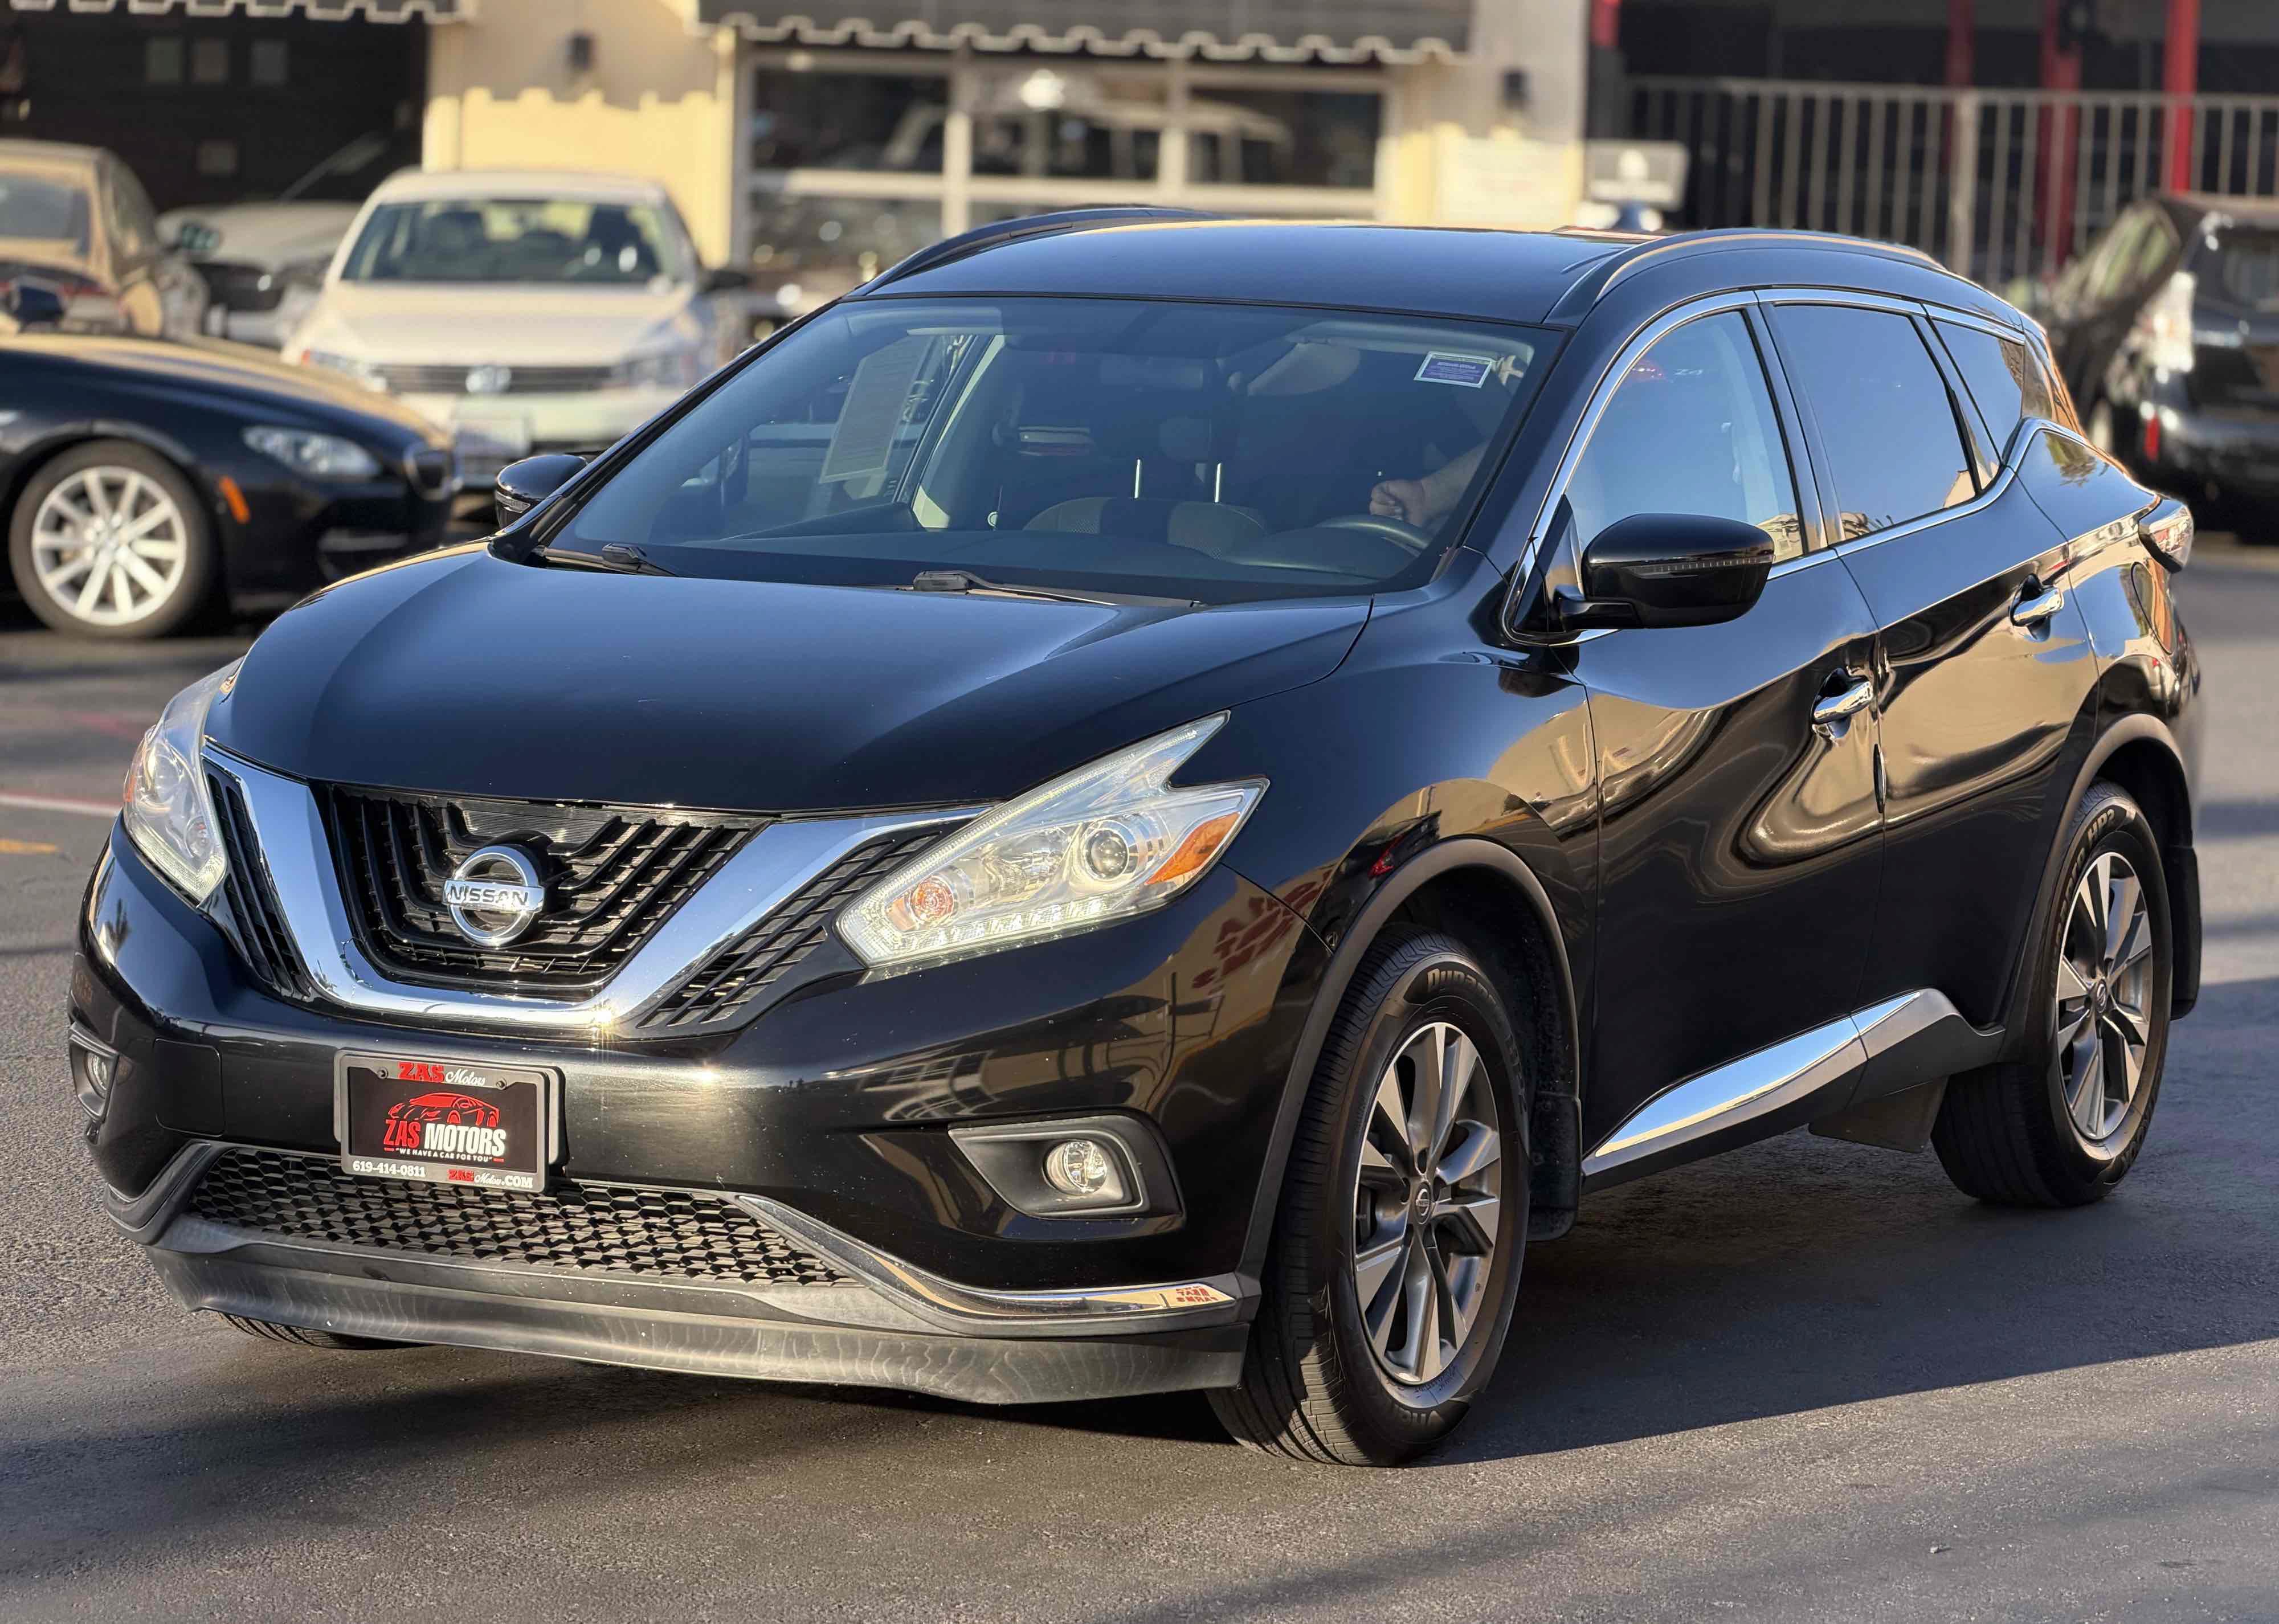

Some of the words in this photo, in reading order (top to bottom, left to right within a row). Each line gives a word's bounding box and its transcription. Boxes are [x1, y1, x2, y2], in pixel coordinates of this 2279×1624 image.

[450, 884, 529, 906] NISSAN
[398, 1061, 444, 1083] ZAS
[383, 1119, 421, 1148] ZAS
[423, 1122, 507, 1157] MOTORS
[412, 1149, 432, 1157] HAVE
[353, 1160, 426, 1177] 619-414-0811
